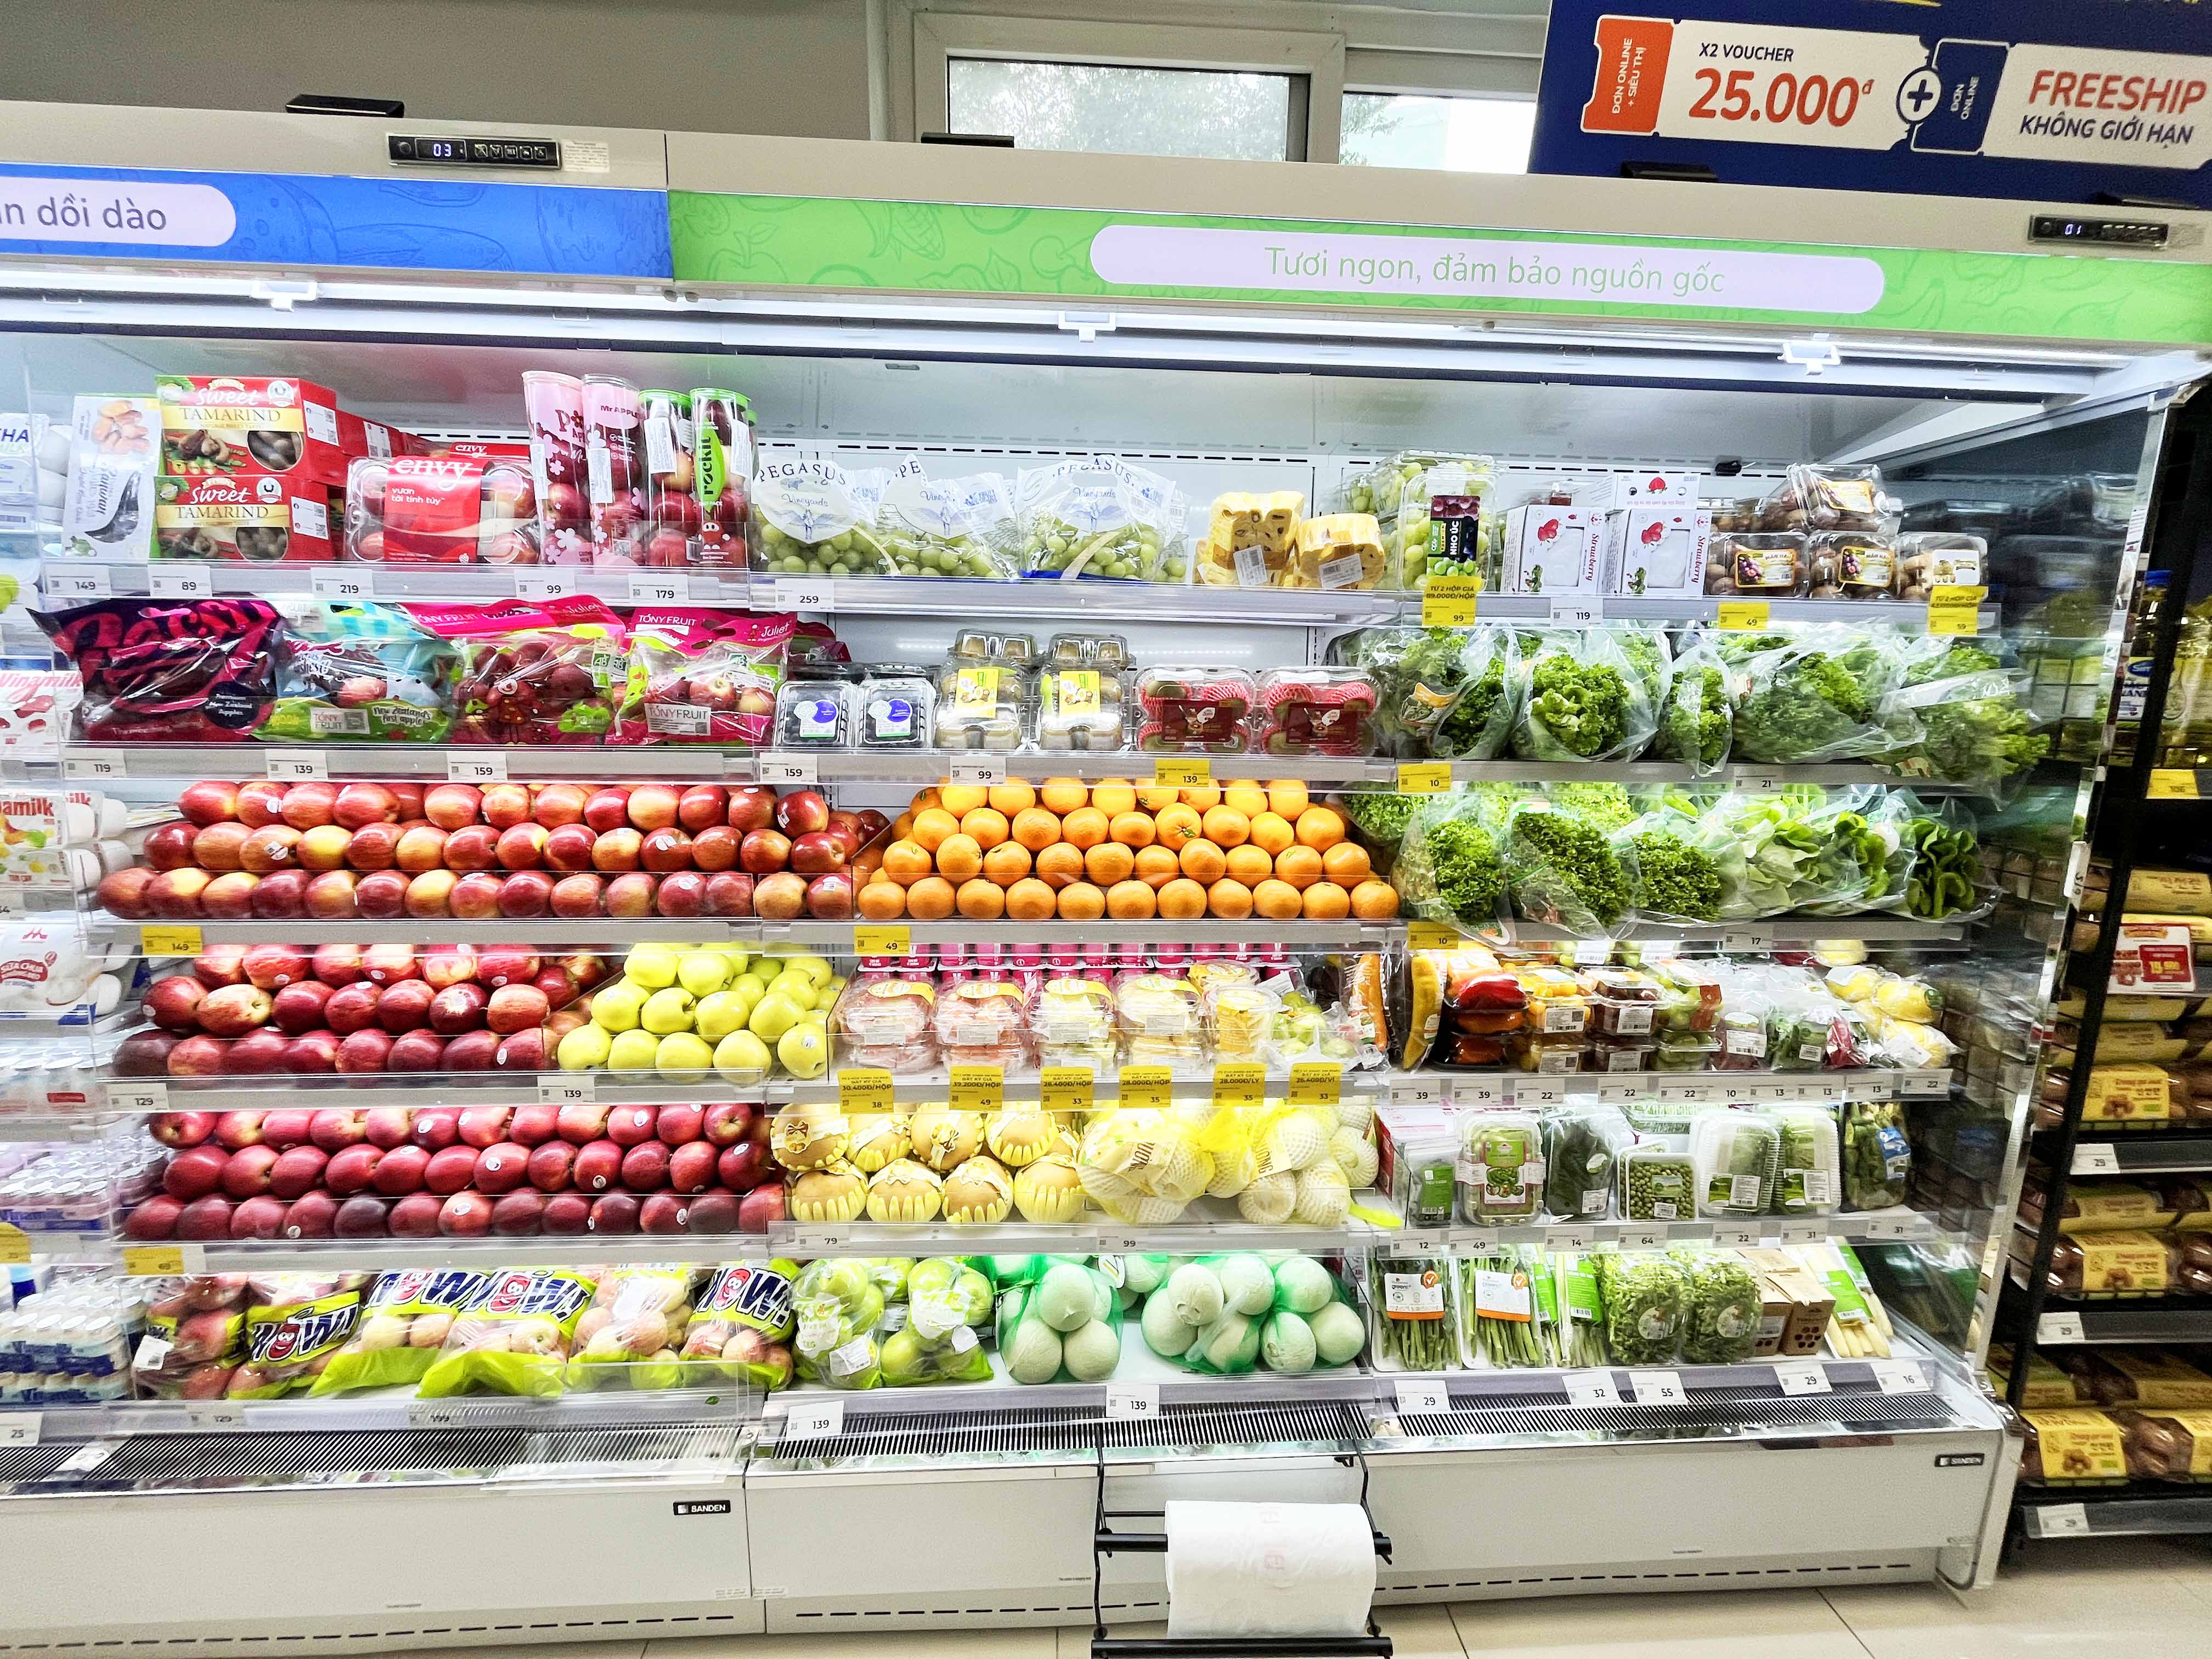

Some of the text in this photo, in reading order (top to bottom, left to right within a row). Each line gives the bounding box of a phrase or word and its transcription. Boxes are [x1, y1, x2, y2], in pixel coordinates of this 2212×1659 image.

[1700, 43, 1794, 62] X2 VOUCHER
[1617, 38, 1633, 84] ONLINE
[2028, 70, 2207, 114] FREESHIP
[2019, 111, 2195, 149] KHÔNG GIỚI HẠN
[433, 144, 452, 157] 03
[37, 193, 167, 230] dồi dào
[1265, 246, 1725, 297] Tươi ngon, đảm bảo nguồn gốc
[196, 388, 262, 406] Sweet
[179, 408, 281, 422] TAMARIND
[455, 444, 487, 458] envy
[701, 436, 713, 495] rockit
[395, 459, 475, 492] envy
[190, 487, 251, 504] Sweet
[176, 505, 269, 519] TAMARIND
[1585, 533, 1600, 582] Strawberry
[1691, 536, 1707, 584] Strawberry
[75, 582, 95, 590] 149
[182, 582, 196, 590] 89
[341, 585, 358, 593] 219
[639, 613, 697, 627] TÓNY FRUIT
[761, 623, 789, 637] Juliet
[374, 706, 390, 715] New
[1805, 1376, 1816, 1385] 29
[1593, 1389, 1605, 1397] 32
[1131, 1401, 1146, 1409] 139
[813, 1420, 829, 1429] 139
